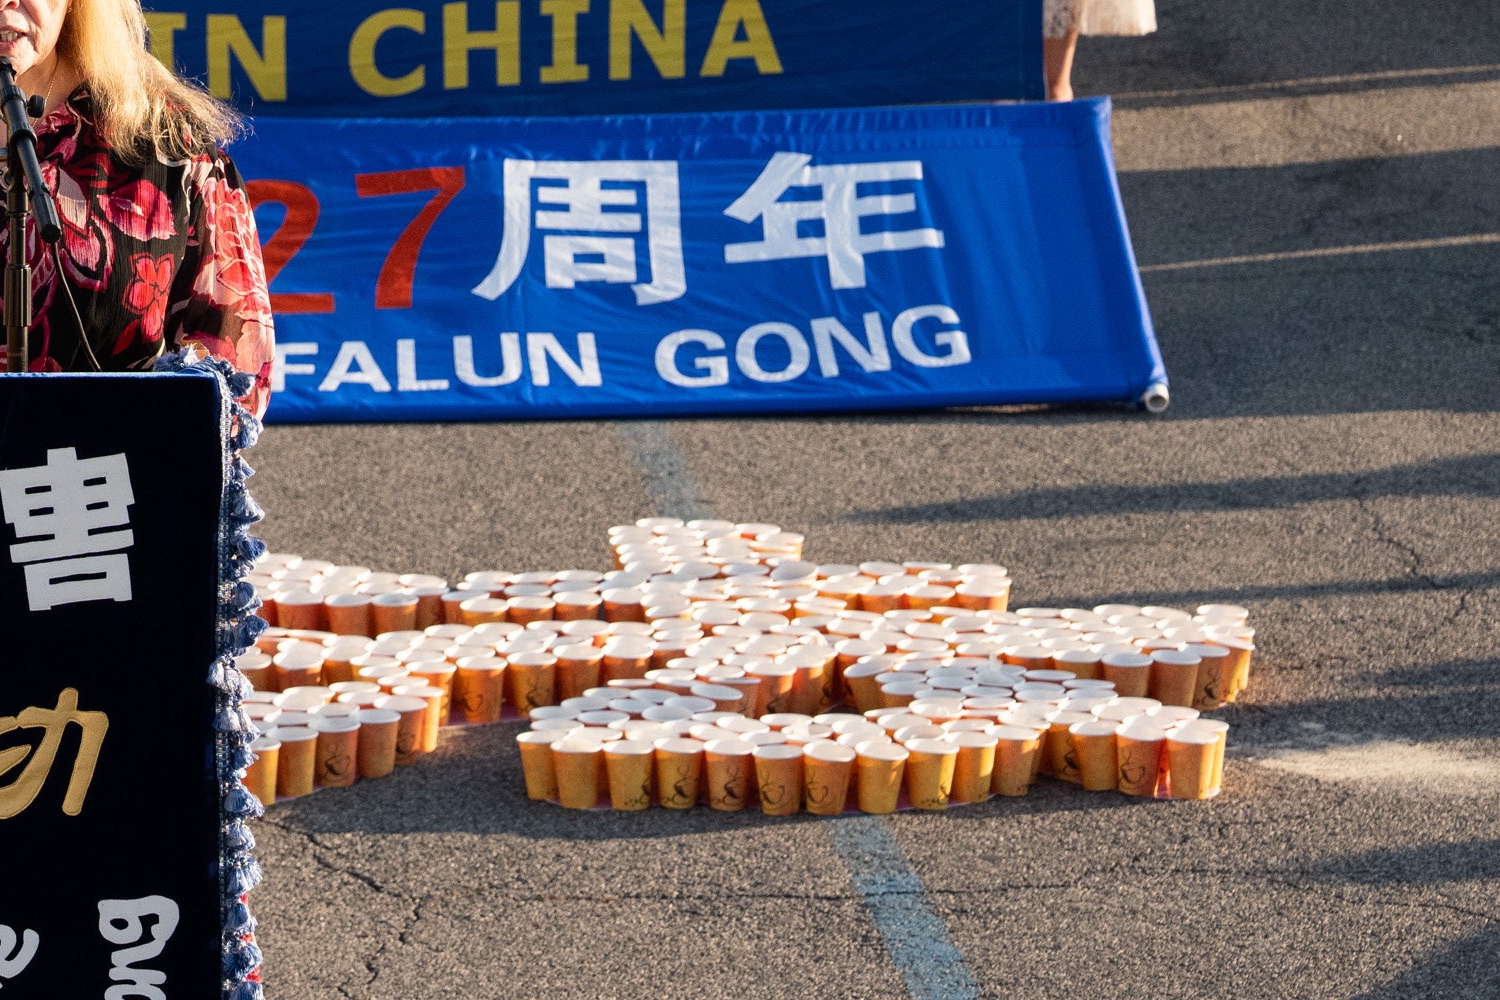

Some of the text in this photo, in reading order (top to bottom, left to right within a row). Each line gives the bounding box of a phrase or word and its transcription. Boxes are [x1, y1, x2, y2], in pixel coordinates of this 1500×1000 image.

[143, 12, 287, 102] IN
[272, 303, 972, 393] FALUN GONG
